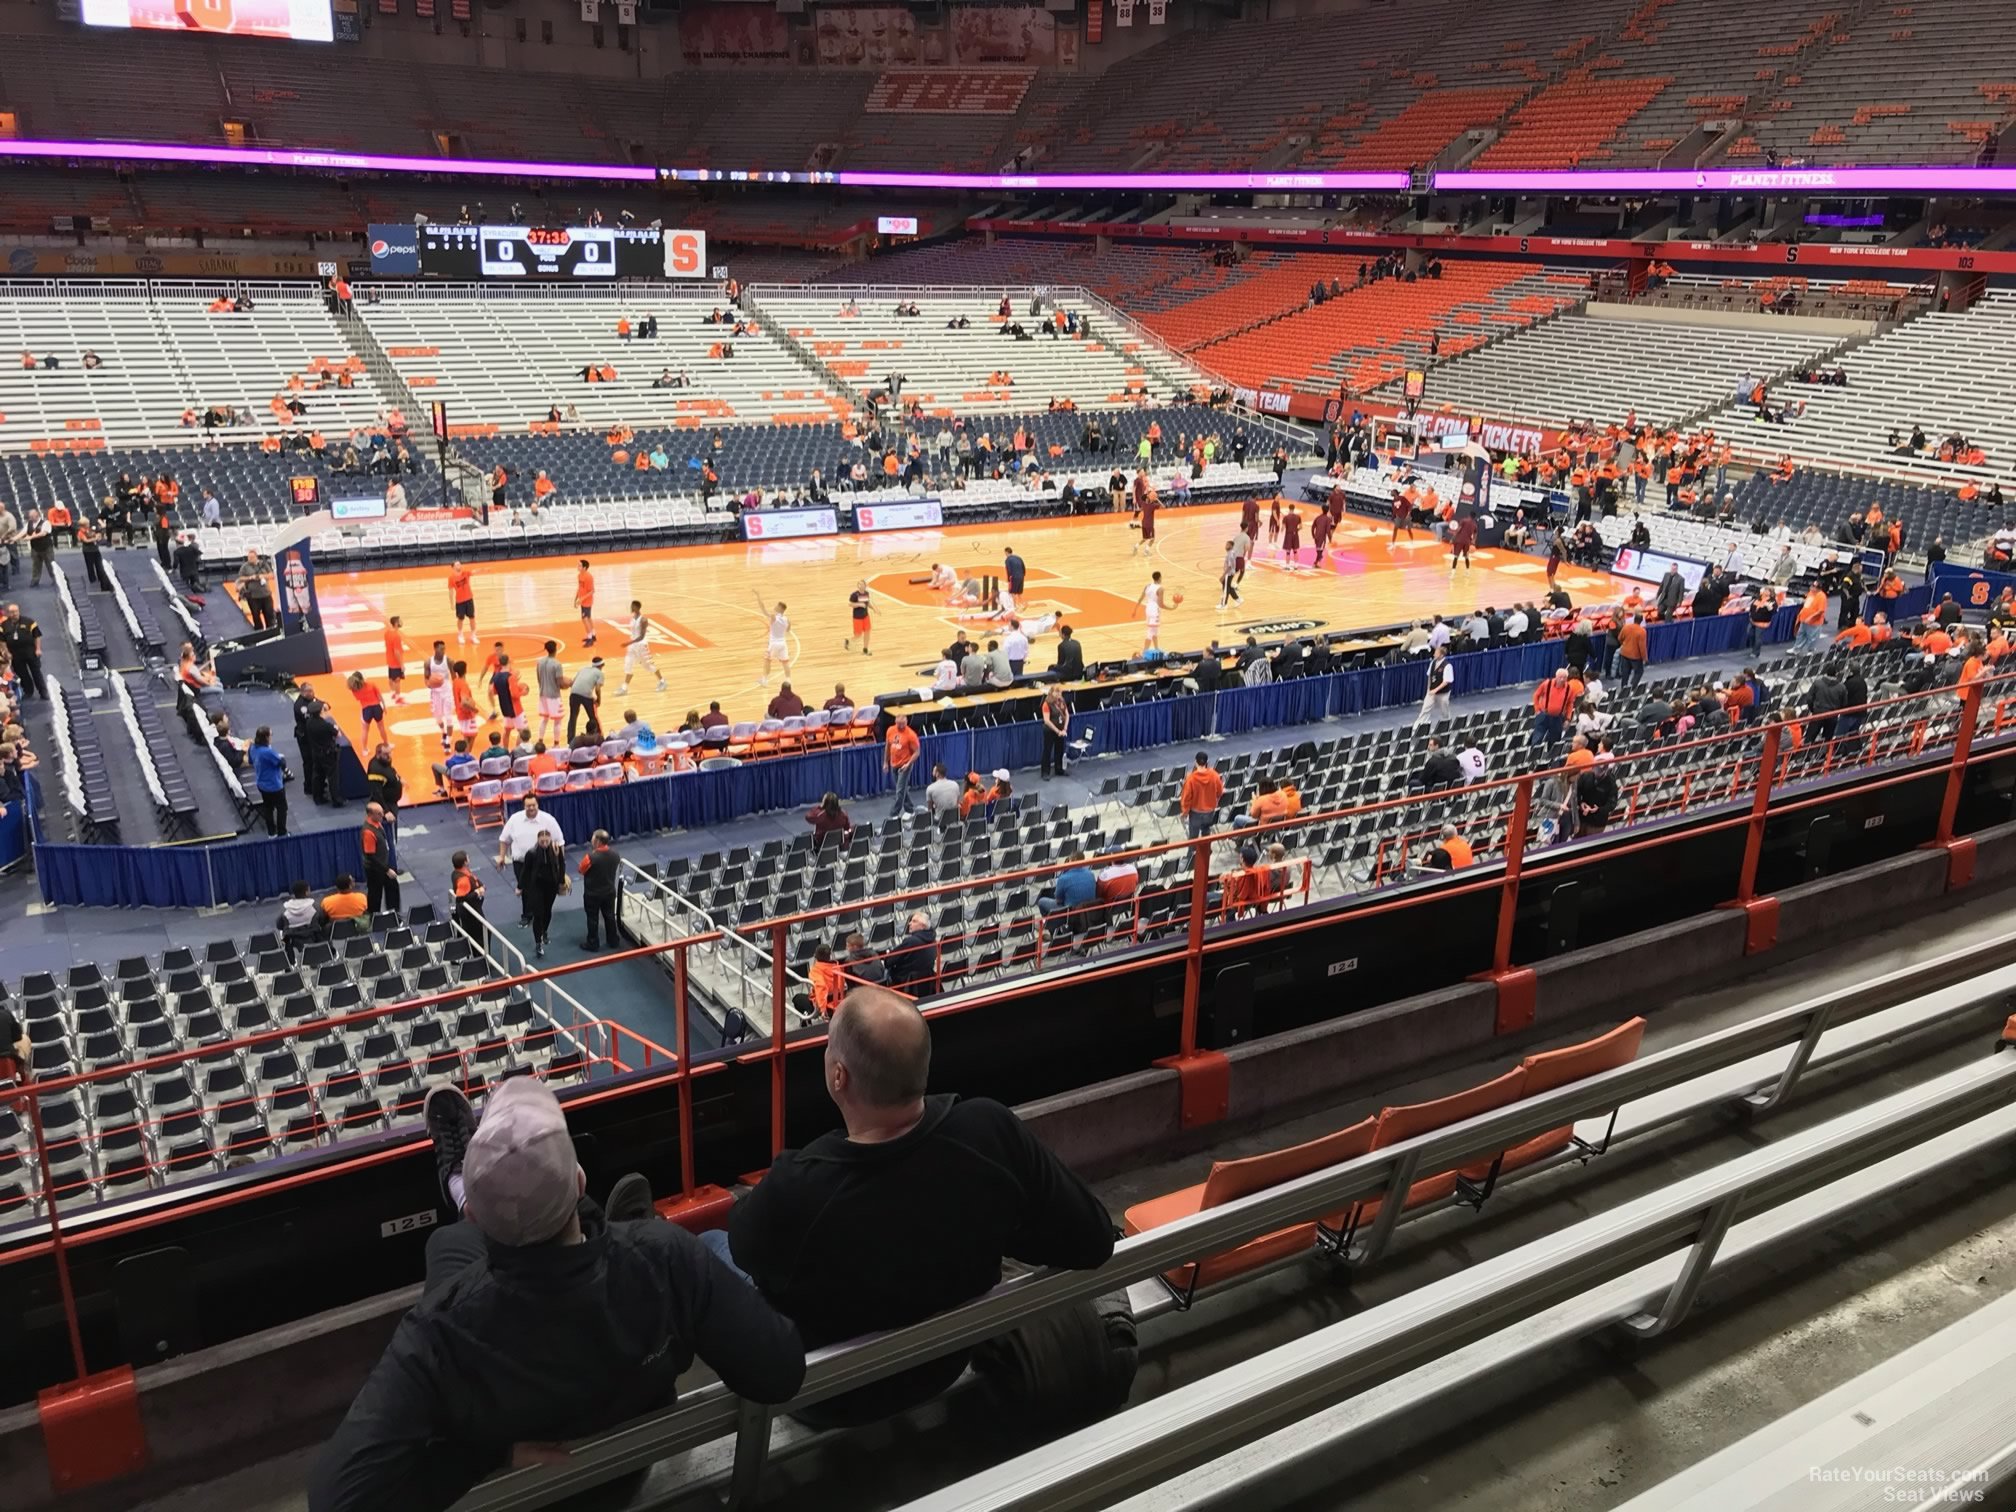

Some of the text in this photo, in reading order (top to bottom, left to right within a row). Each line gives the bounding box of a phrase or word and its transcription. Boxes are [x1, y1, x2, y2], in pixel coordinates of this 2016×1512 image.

[1120, 8, 1131, 18] 88
[1153, 7, 1163, 16] 39
[1730, 174, 1778, 185] PLANET
[529, 231, 569, 244] 37:38
[390, 244, 416, 254] pepsi
[498, 241, 513, 261] 0
[1520, 238, 1530, 252] S
[584, 243, 599, 262] 0
[673, 235, 698, 272] S
[1786, 247, 1798, 263] S
[1865, 248, 1891, 256] COLLEGE
[65, 254, 97, 265] Coors
[1958, 256, 1974, 268] 103
[320, 264, 336, 275] 123
[714, 268, 728, 278] 124
[1259, 391, 1291, 412] TEAM
[1479, 424, 1543, 454] TICKETS
[1971, 581, 1990, 605] S
[1332, 960, 1355, 973] 124
[389, 1213, 432, 1232] 125
